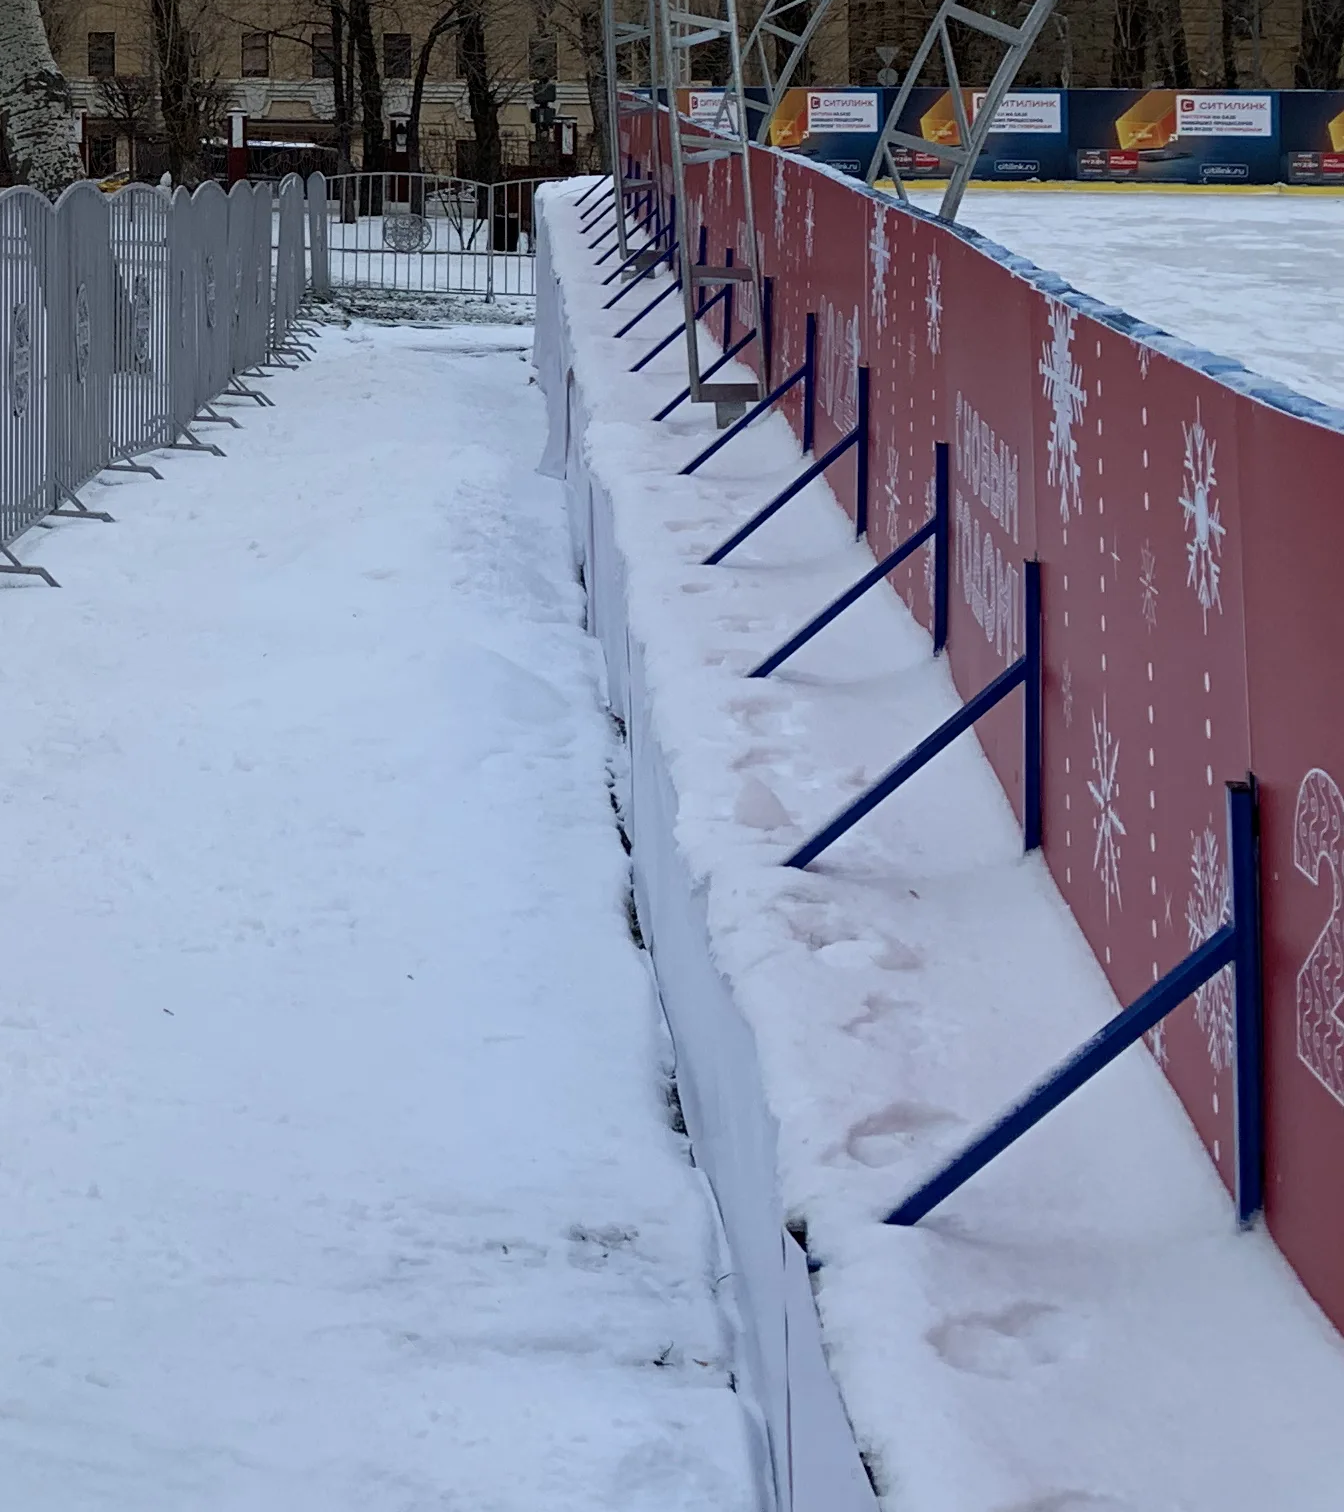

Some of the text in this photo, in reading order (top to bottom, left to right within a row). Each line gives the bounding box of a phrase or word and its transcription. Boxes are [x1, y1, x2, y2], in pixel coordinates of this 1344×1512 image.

[823, 99, 874, 107] СИТИЛИНК
[1001, 99, 1057, 108] ИТИЛИНК
[1199, 101, 1267, 110] СИТИЛИНК
